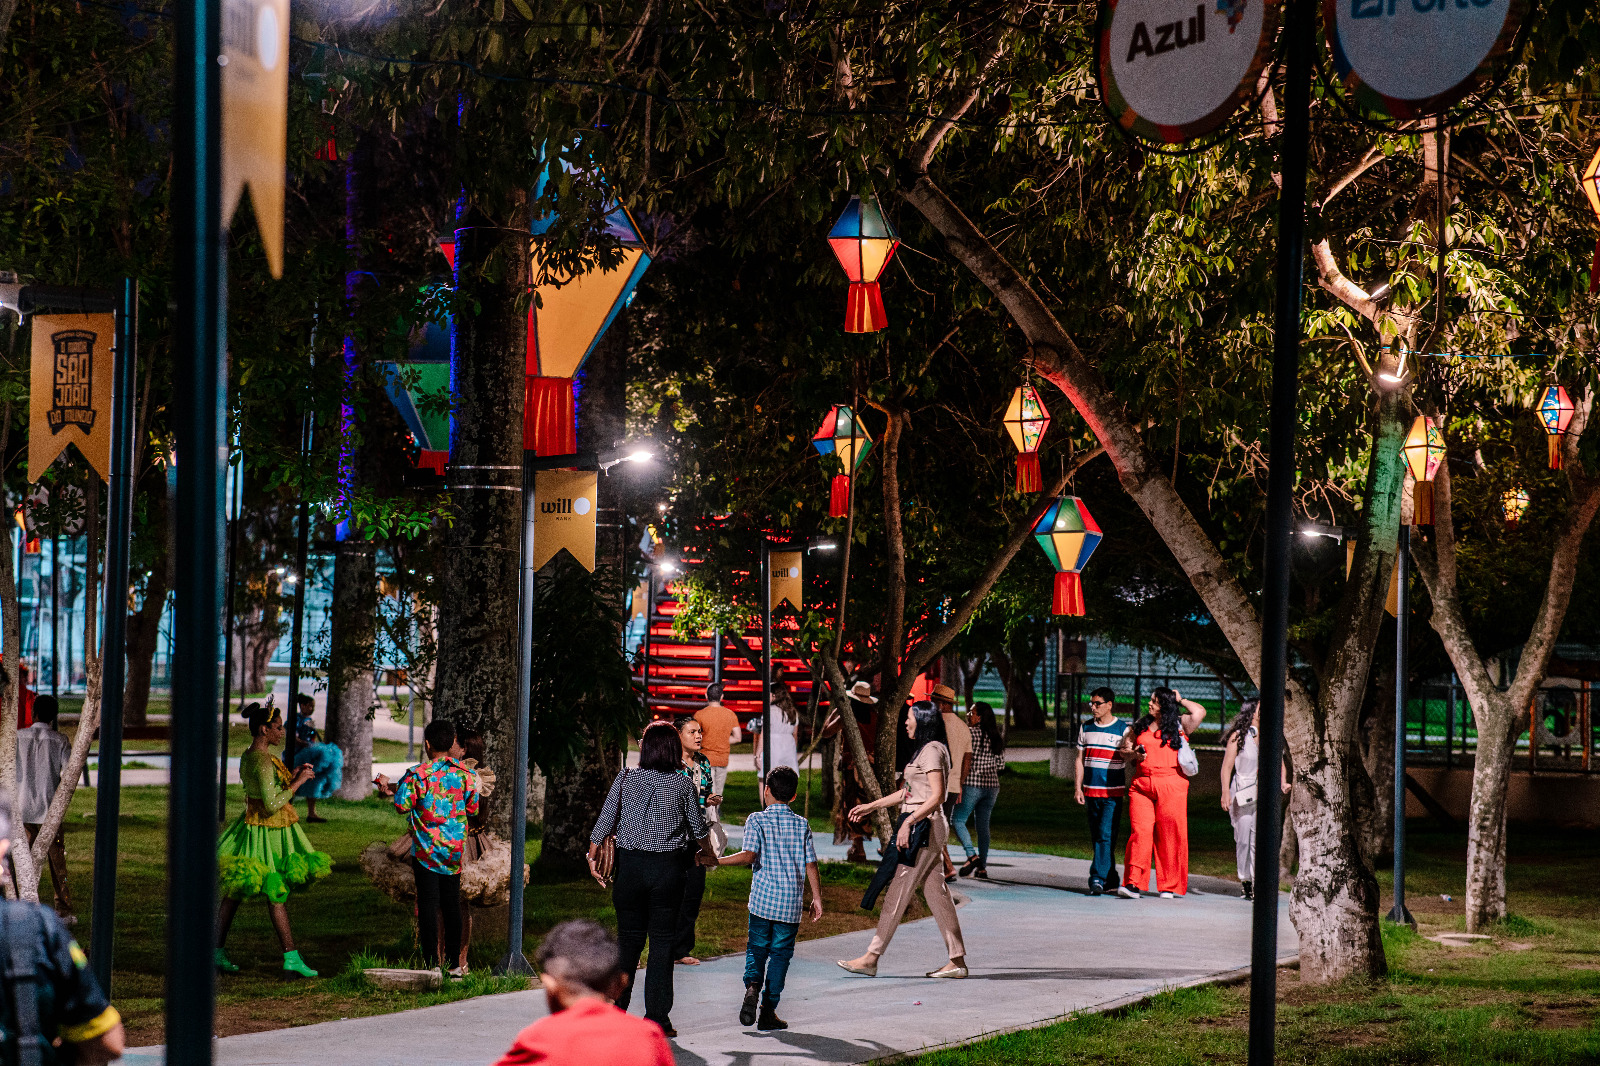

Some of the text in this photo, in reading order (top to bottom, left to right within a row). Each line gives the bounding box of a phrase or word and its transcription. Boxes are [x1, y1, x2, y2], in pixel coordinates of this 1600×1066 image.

[1126, 4, 1205, 62] Azul
[56, 354, 90, 384] SÃO
[55, 384, 89, 407] JOÃO
[541, 498, 571, 513] will
[772, 568, 788, 577] will
